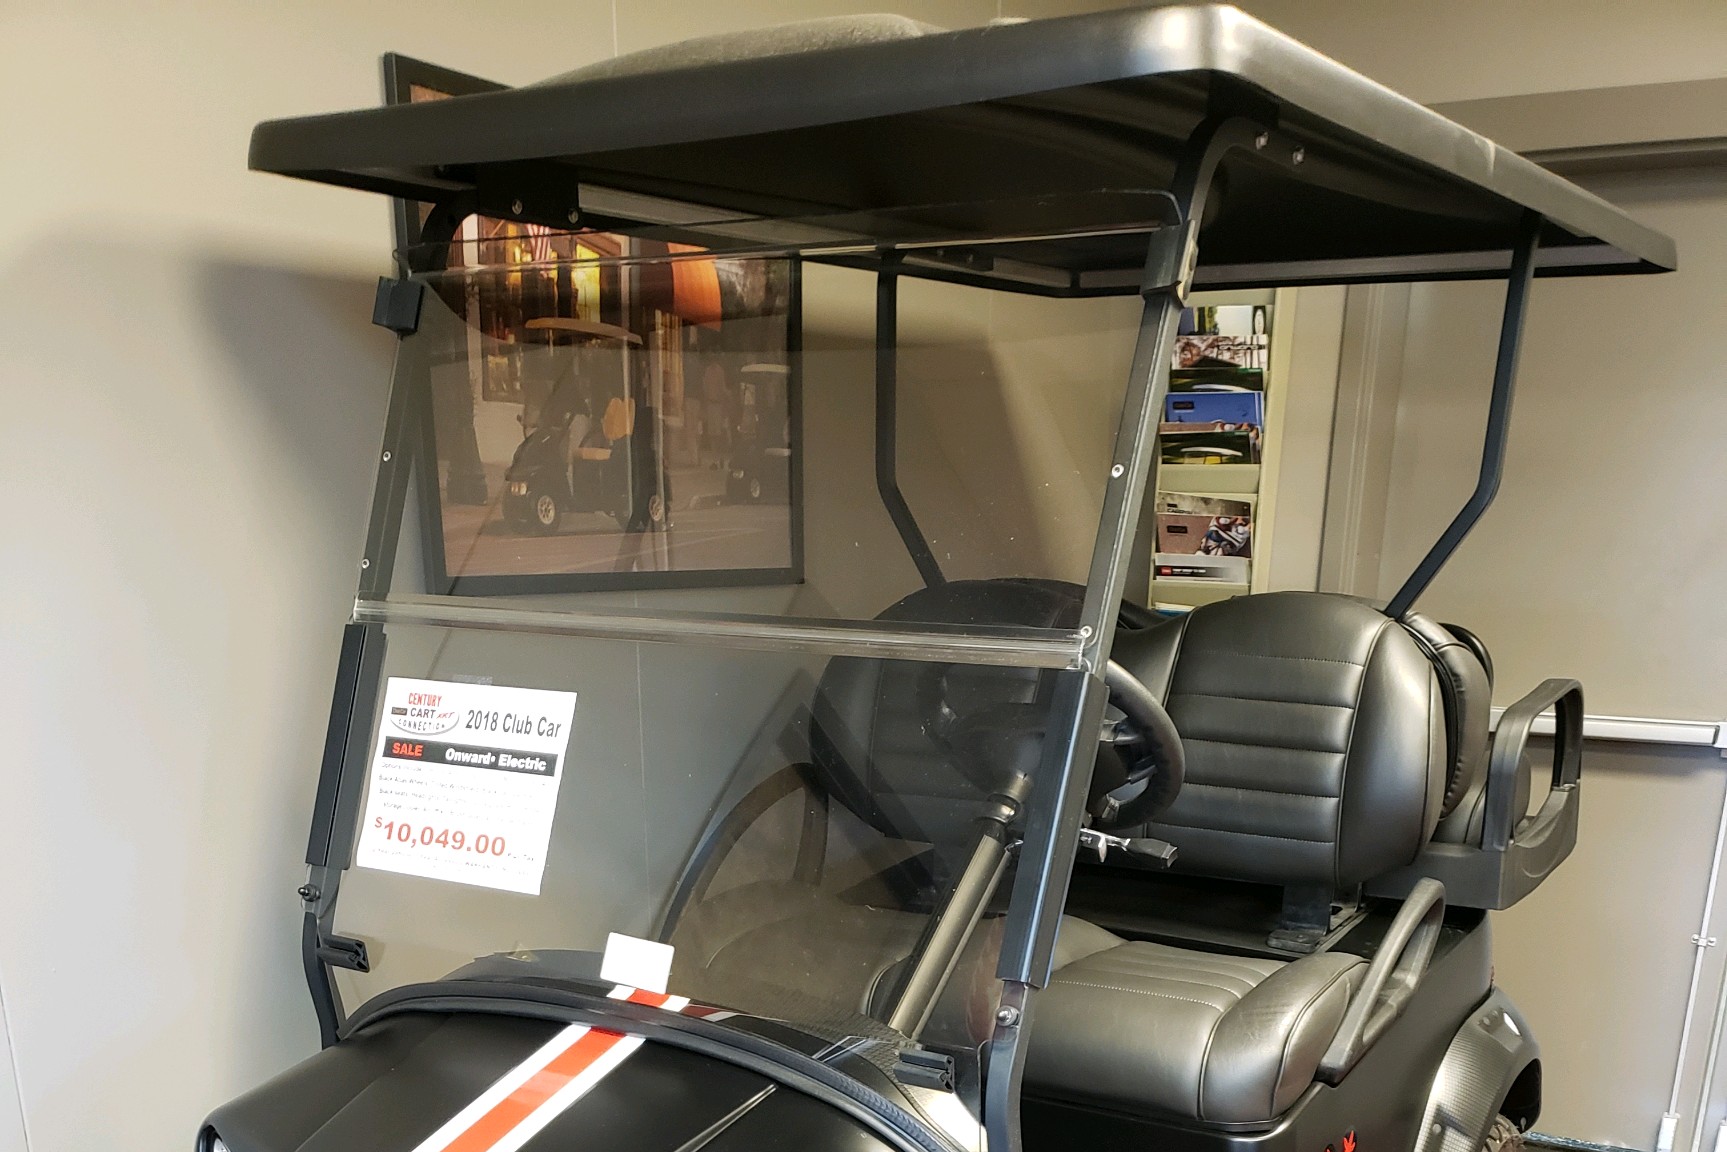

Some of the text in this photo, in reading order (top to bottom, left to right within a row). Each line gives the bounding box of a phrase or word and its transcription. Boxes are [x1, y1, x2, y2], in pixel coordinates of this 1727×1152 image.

[408, 692, 442, 708] CENTURY
[410, 707, 437, 719] CART
[465, 709, 562, 738] 2018 Club Car
[392, 742, 424, 757] SALE
[498, 754, 547, 771] Electric
[374, 816, 506, 857] $10,049.00
